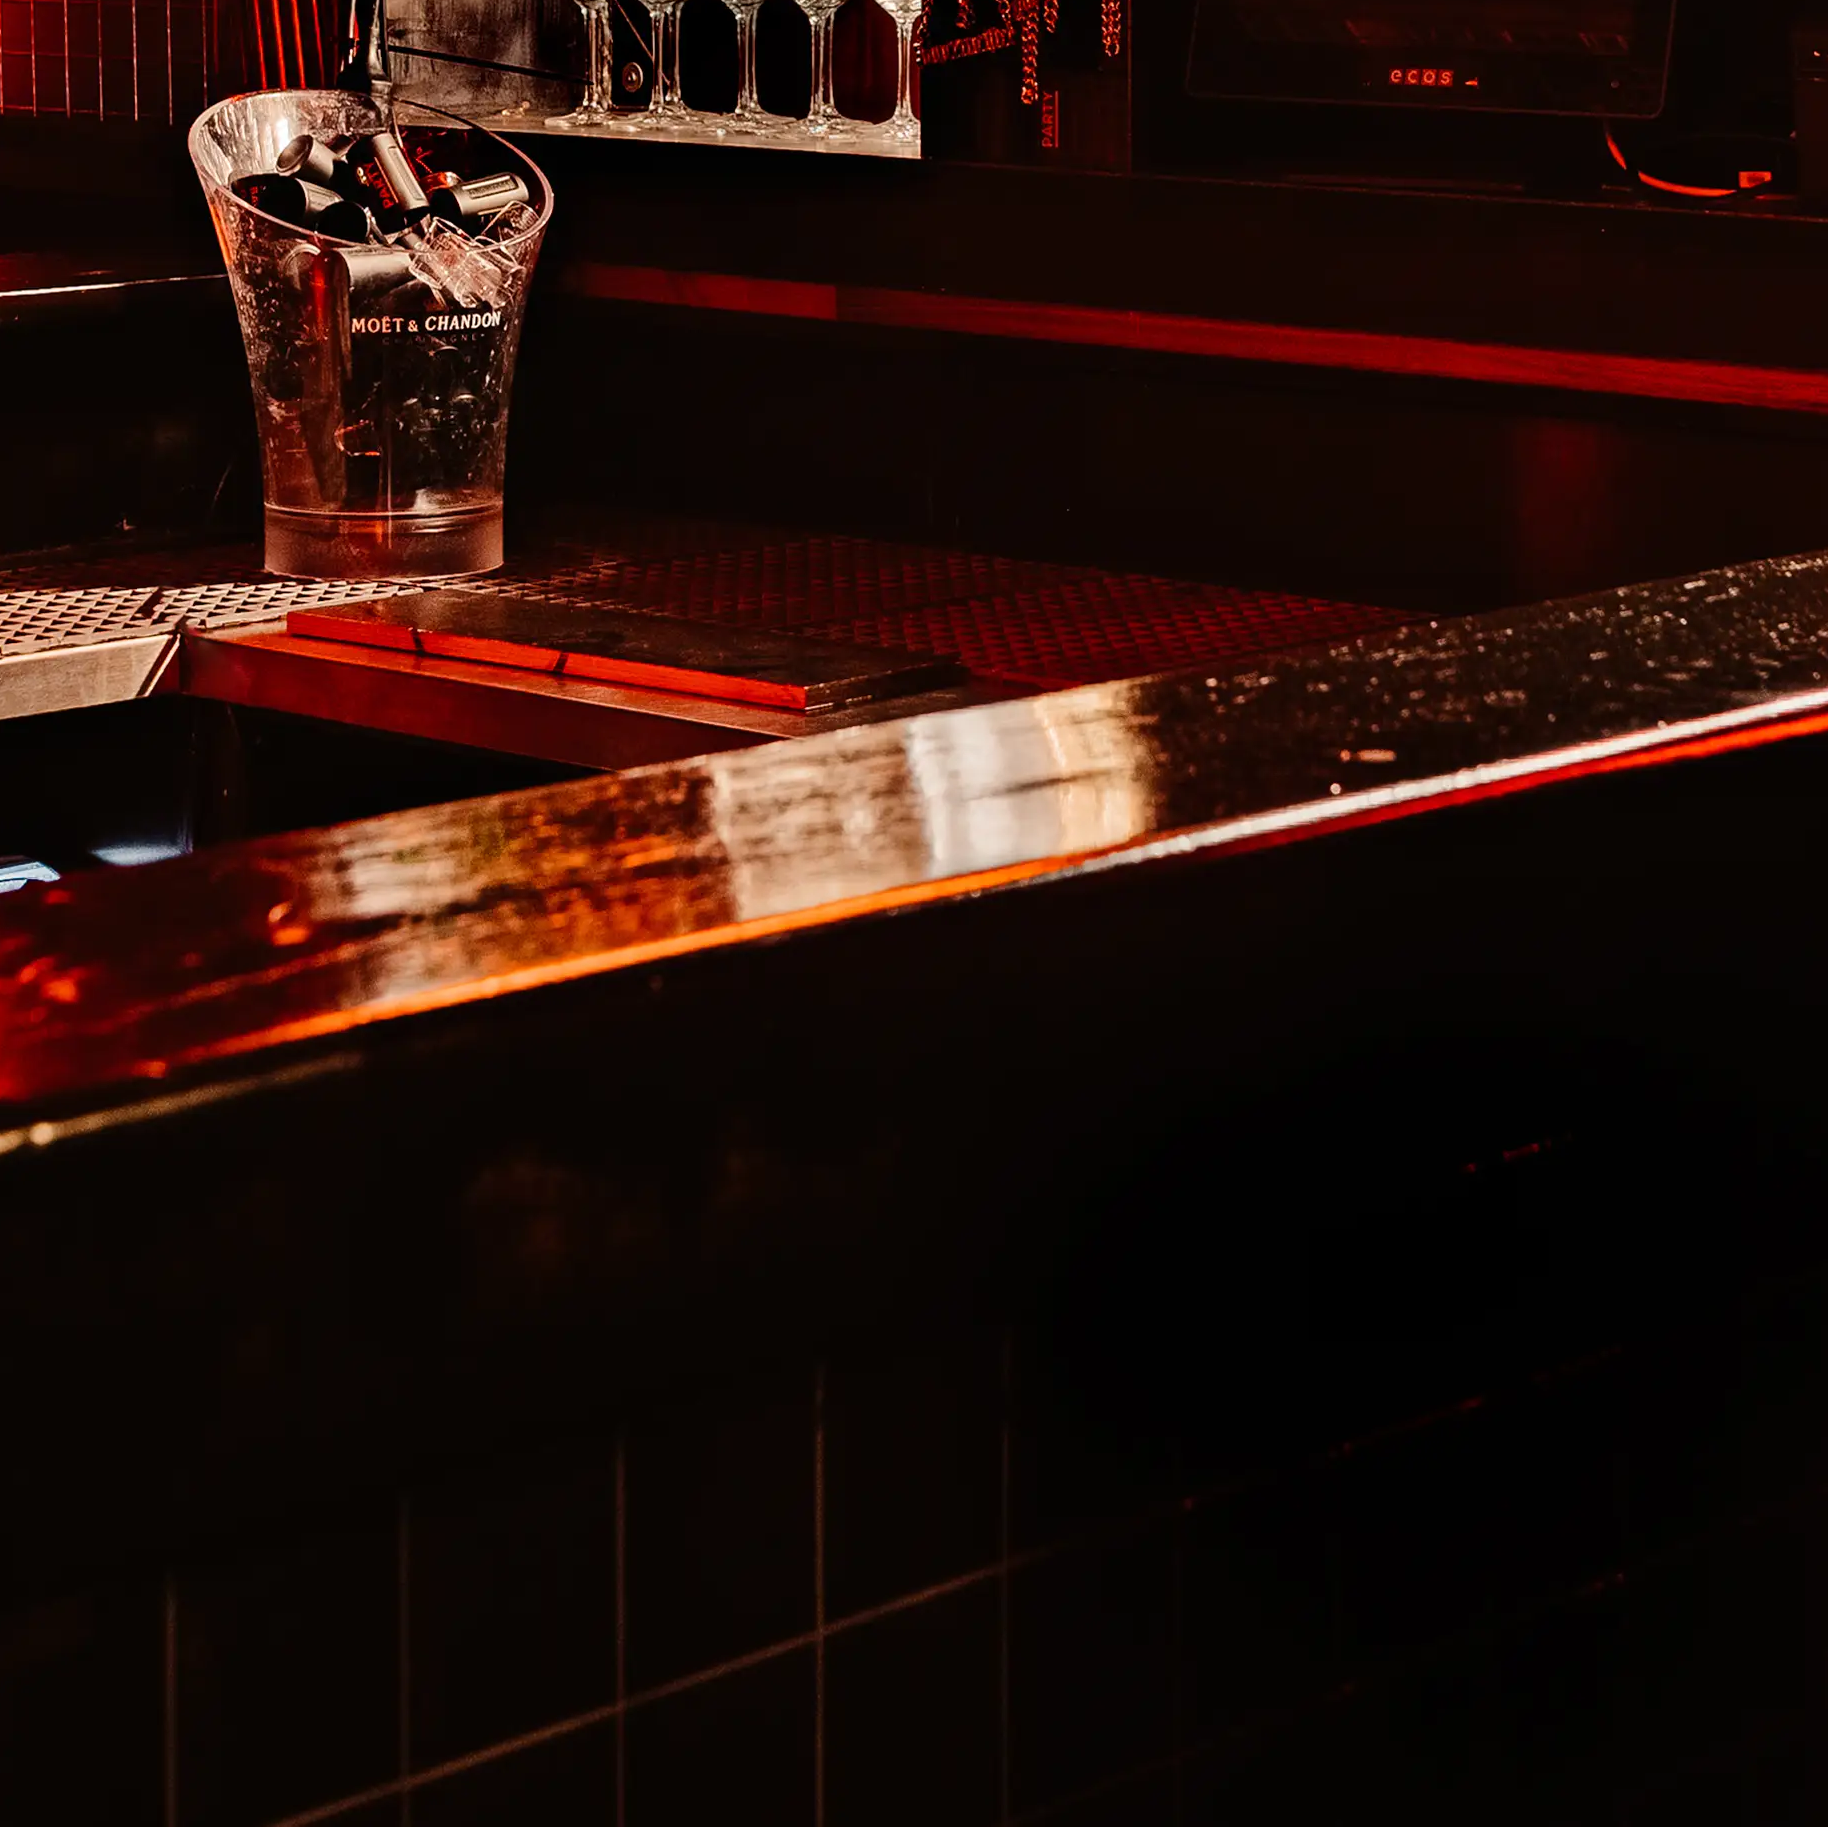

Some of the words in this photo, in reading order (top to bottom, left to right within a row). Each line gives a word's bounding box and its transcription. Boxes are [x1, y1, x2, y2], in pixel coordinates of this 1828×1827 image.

[1389, 68, 1453, 86] ecos
[1041, 90, 1054, 148] PARTY
[362, 162, 394, 209] PARTY
[350, 314, 405, 334] MOËT
[407, 319, 419, 333] &
[424, 310, 502, 332] CHANDON
